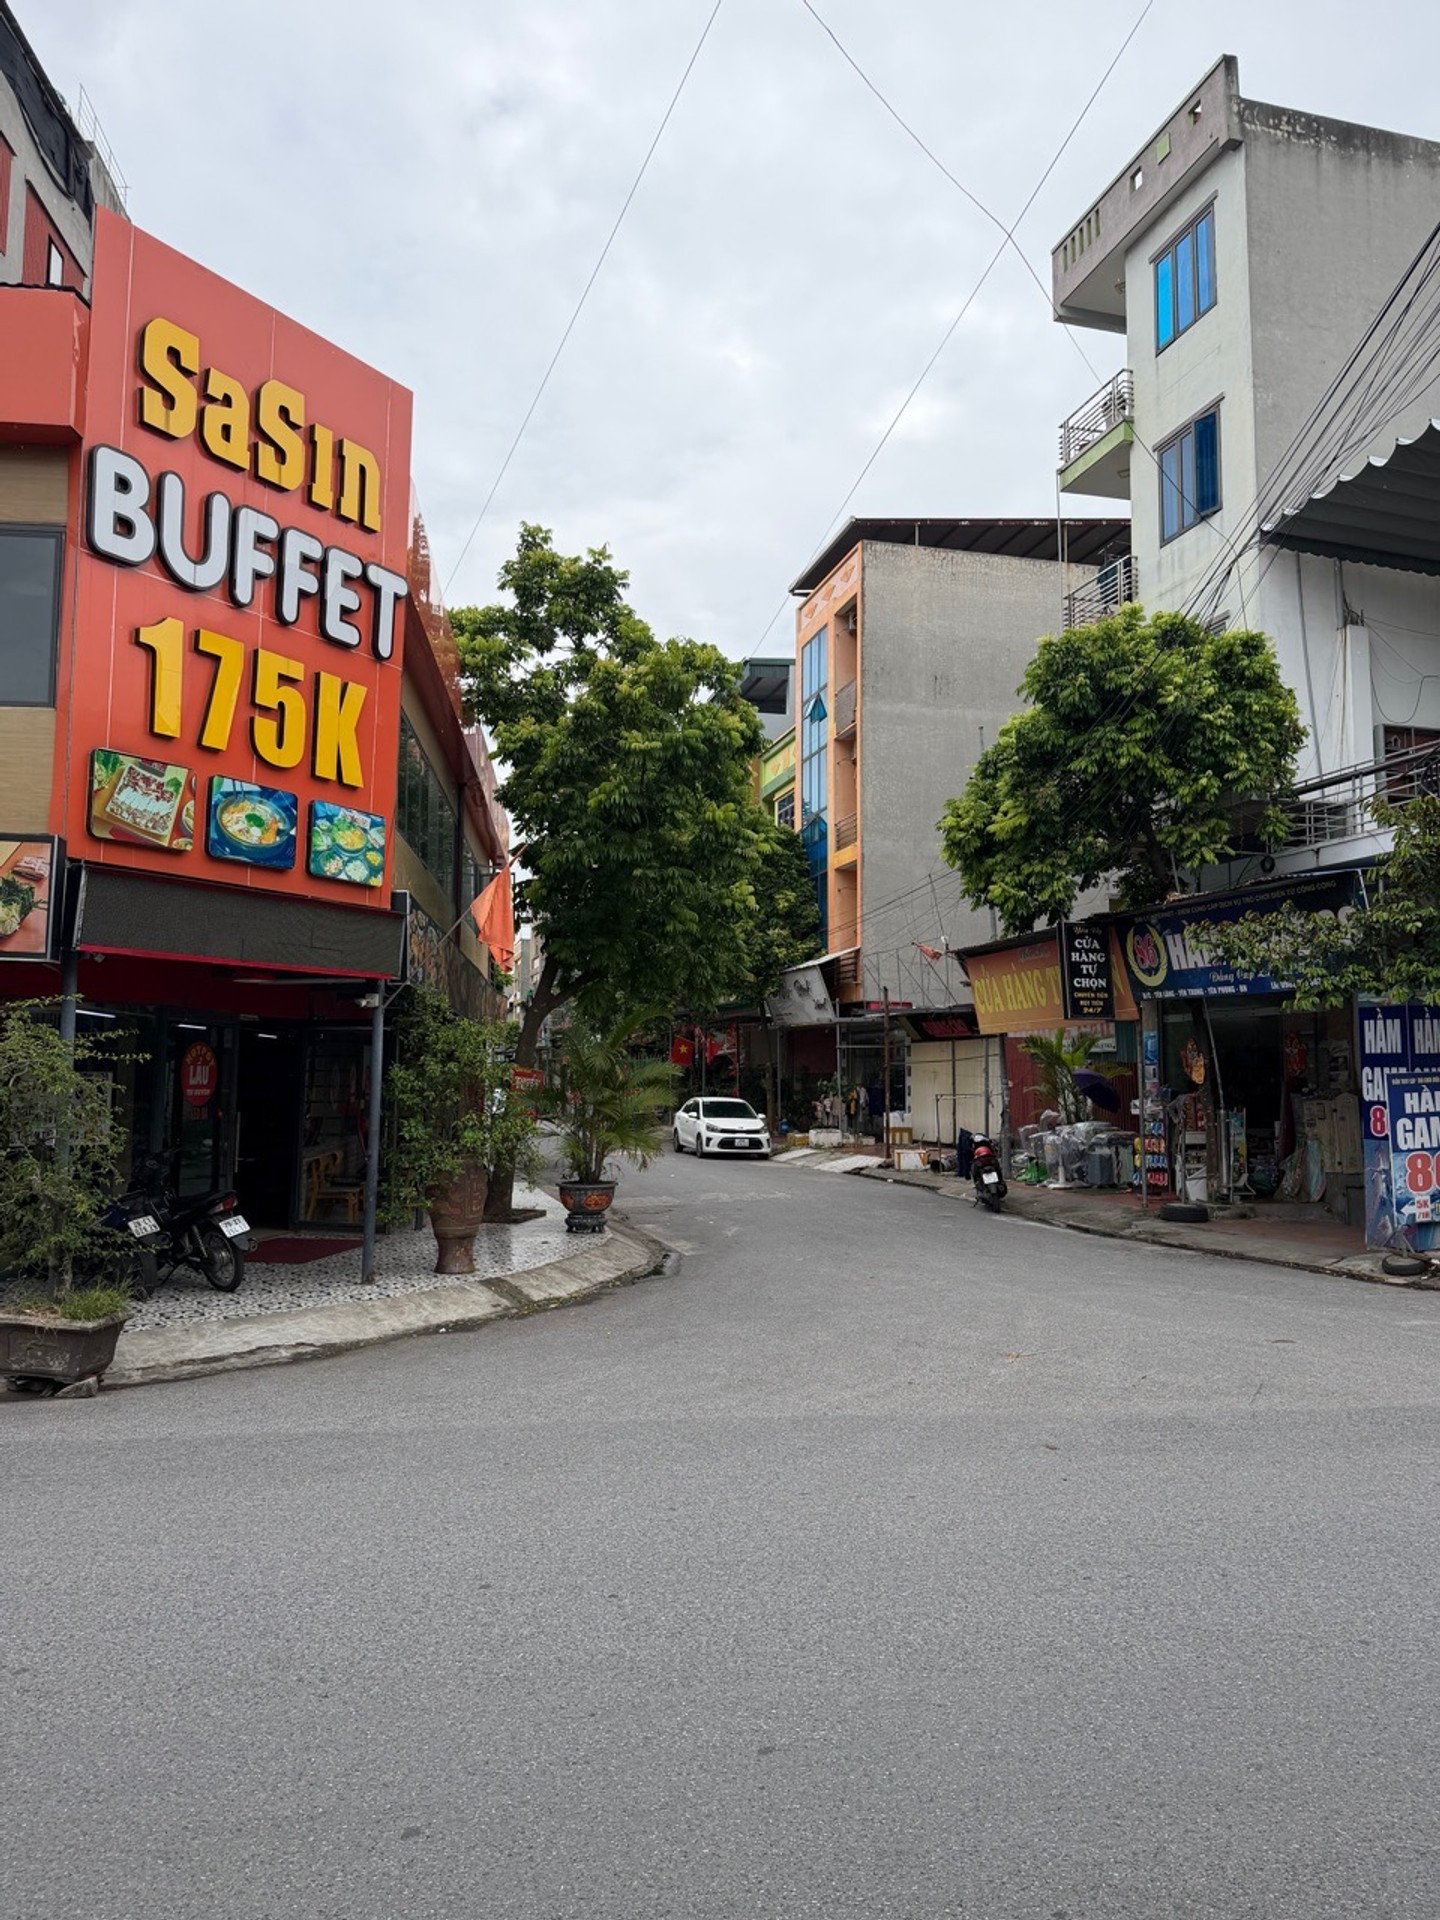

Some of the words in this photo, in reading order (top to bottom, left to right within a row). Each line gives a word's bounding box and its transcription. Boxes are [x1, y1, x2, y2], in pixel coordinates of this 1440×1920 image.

[139, 317, 382, 533] SaSin
[87, 443, 408, 661] BUFFET
[136, 616, 368, 789] 175K
[1071, 949, 1106, 963] HÀNG
[1074, 935, 1100, 949] CỬA
[1134, 933, 1158, 968] 86
[974, 963, 1004, 1014] CỬA
[1001, 961, 1046, 1011] HÀNG
[1073, 978, 1107, 990] CHỌN
[1080, 963, 1097, 977] TỰ
[1364, 1008, 1402, 1054] HÀM
[1369, 1105, 1388, 1137] 8
[1406, 1151, 1440, 1194] 8
